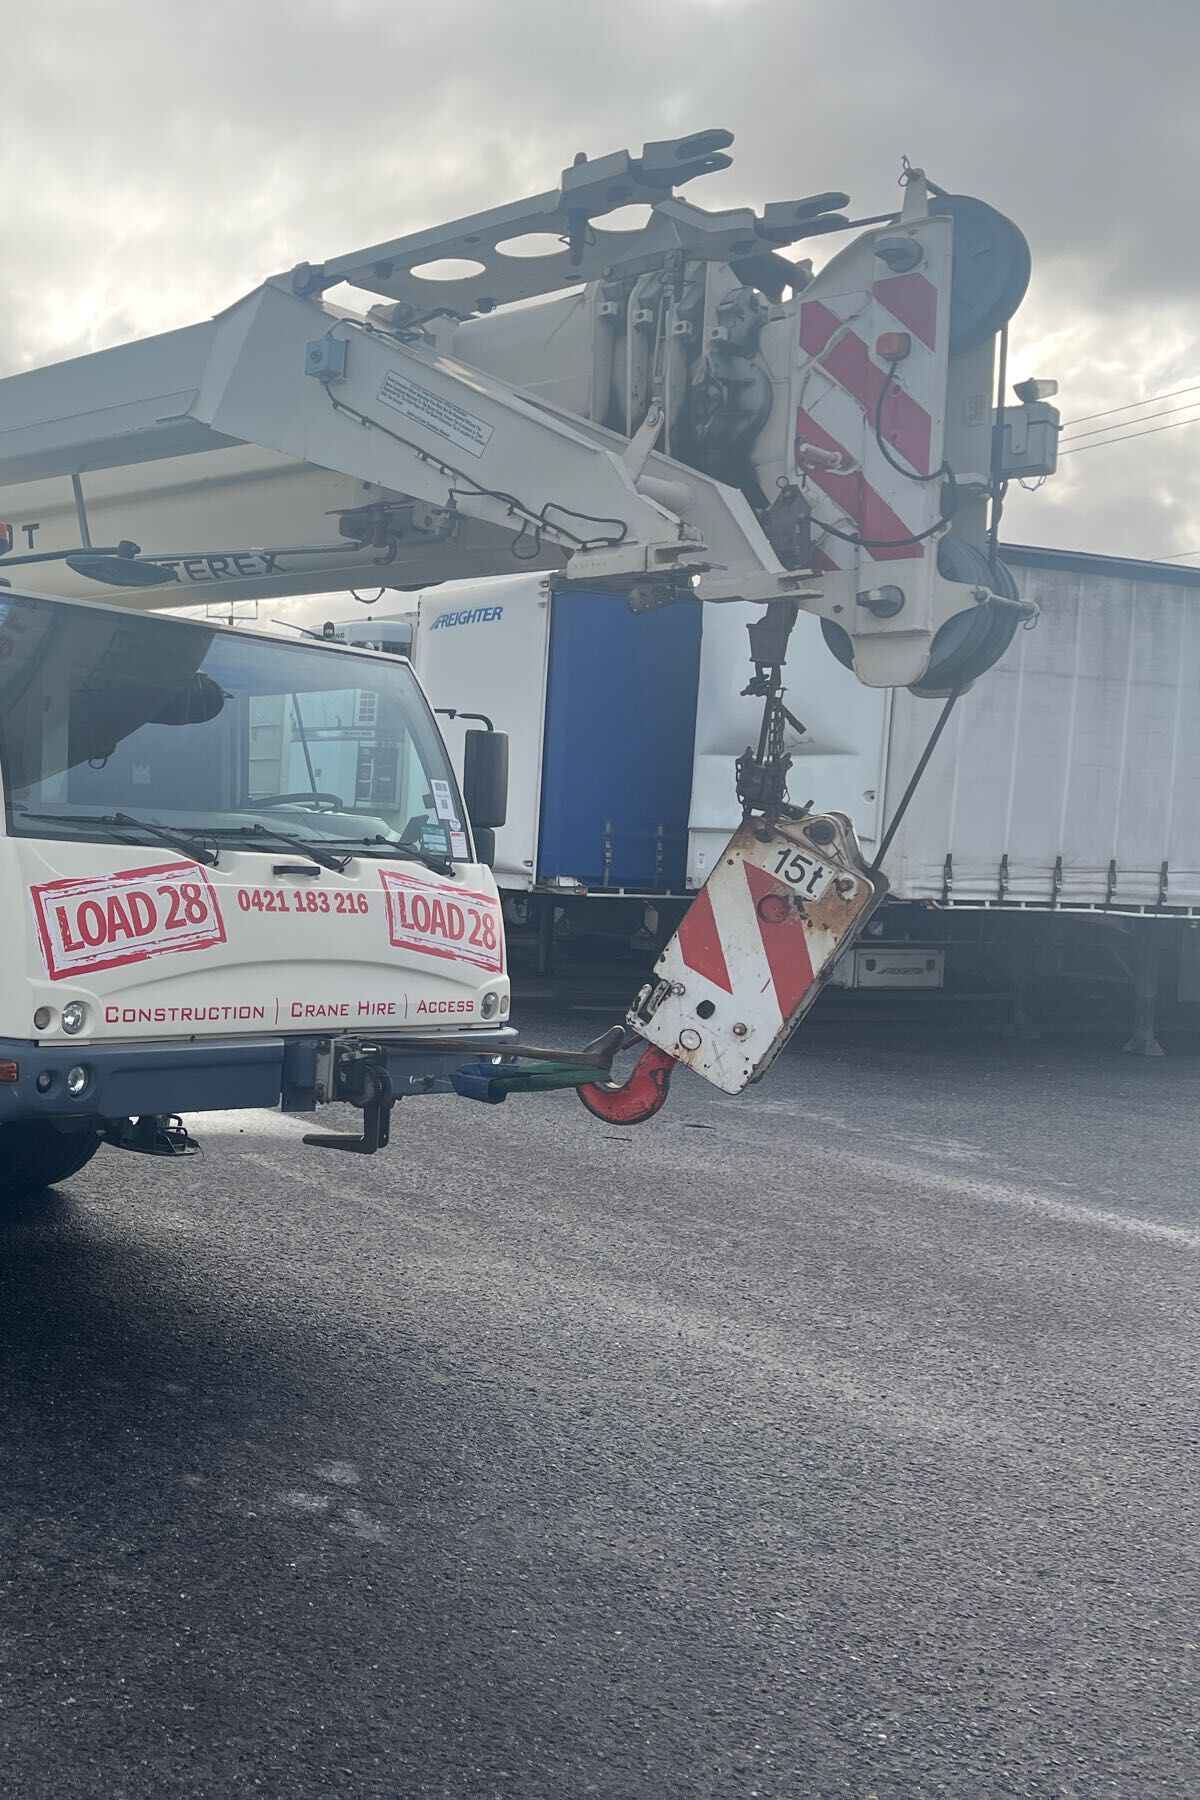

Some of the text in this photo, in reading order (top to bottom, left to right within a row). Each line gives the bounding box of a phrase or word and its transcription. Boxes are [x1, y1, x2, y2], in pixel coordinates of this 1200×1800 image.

[430, 606, 504, 631] FREIGHTER
[774, 847, 824, 895] 15t
[55, 883, 208, 954] LOAD 28
[238, 889, 369, 915] 0421 183 216
[398, 891, 497, 950] LOAD 28
